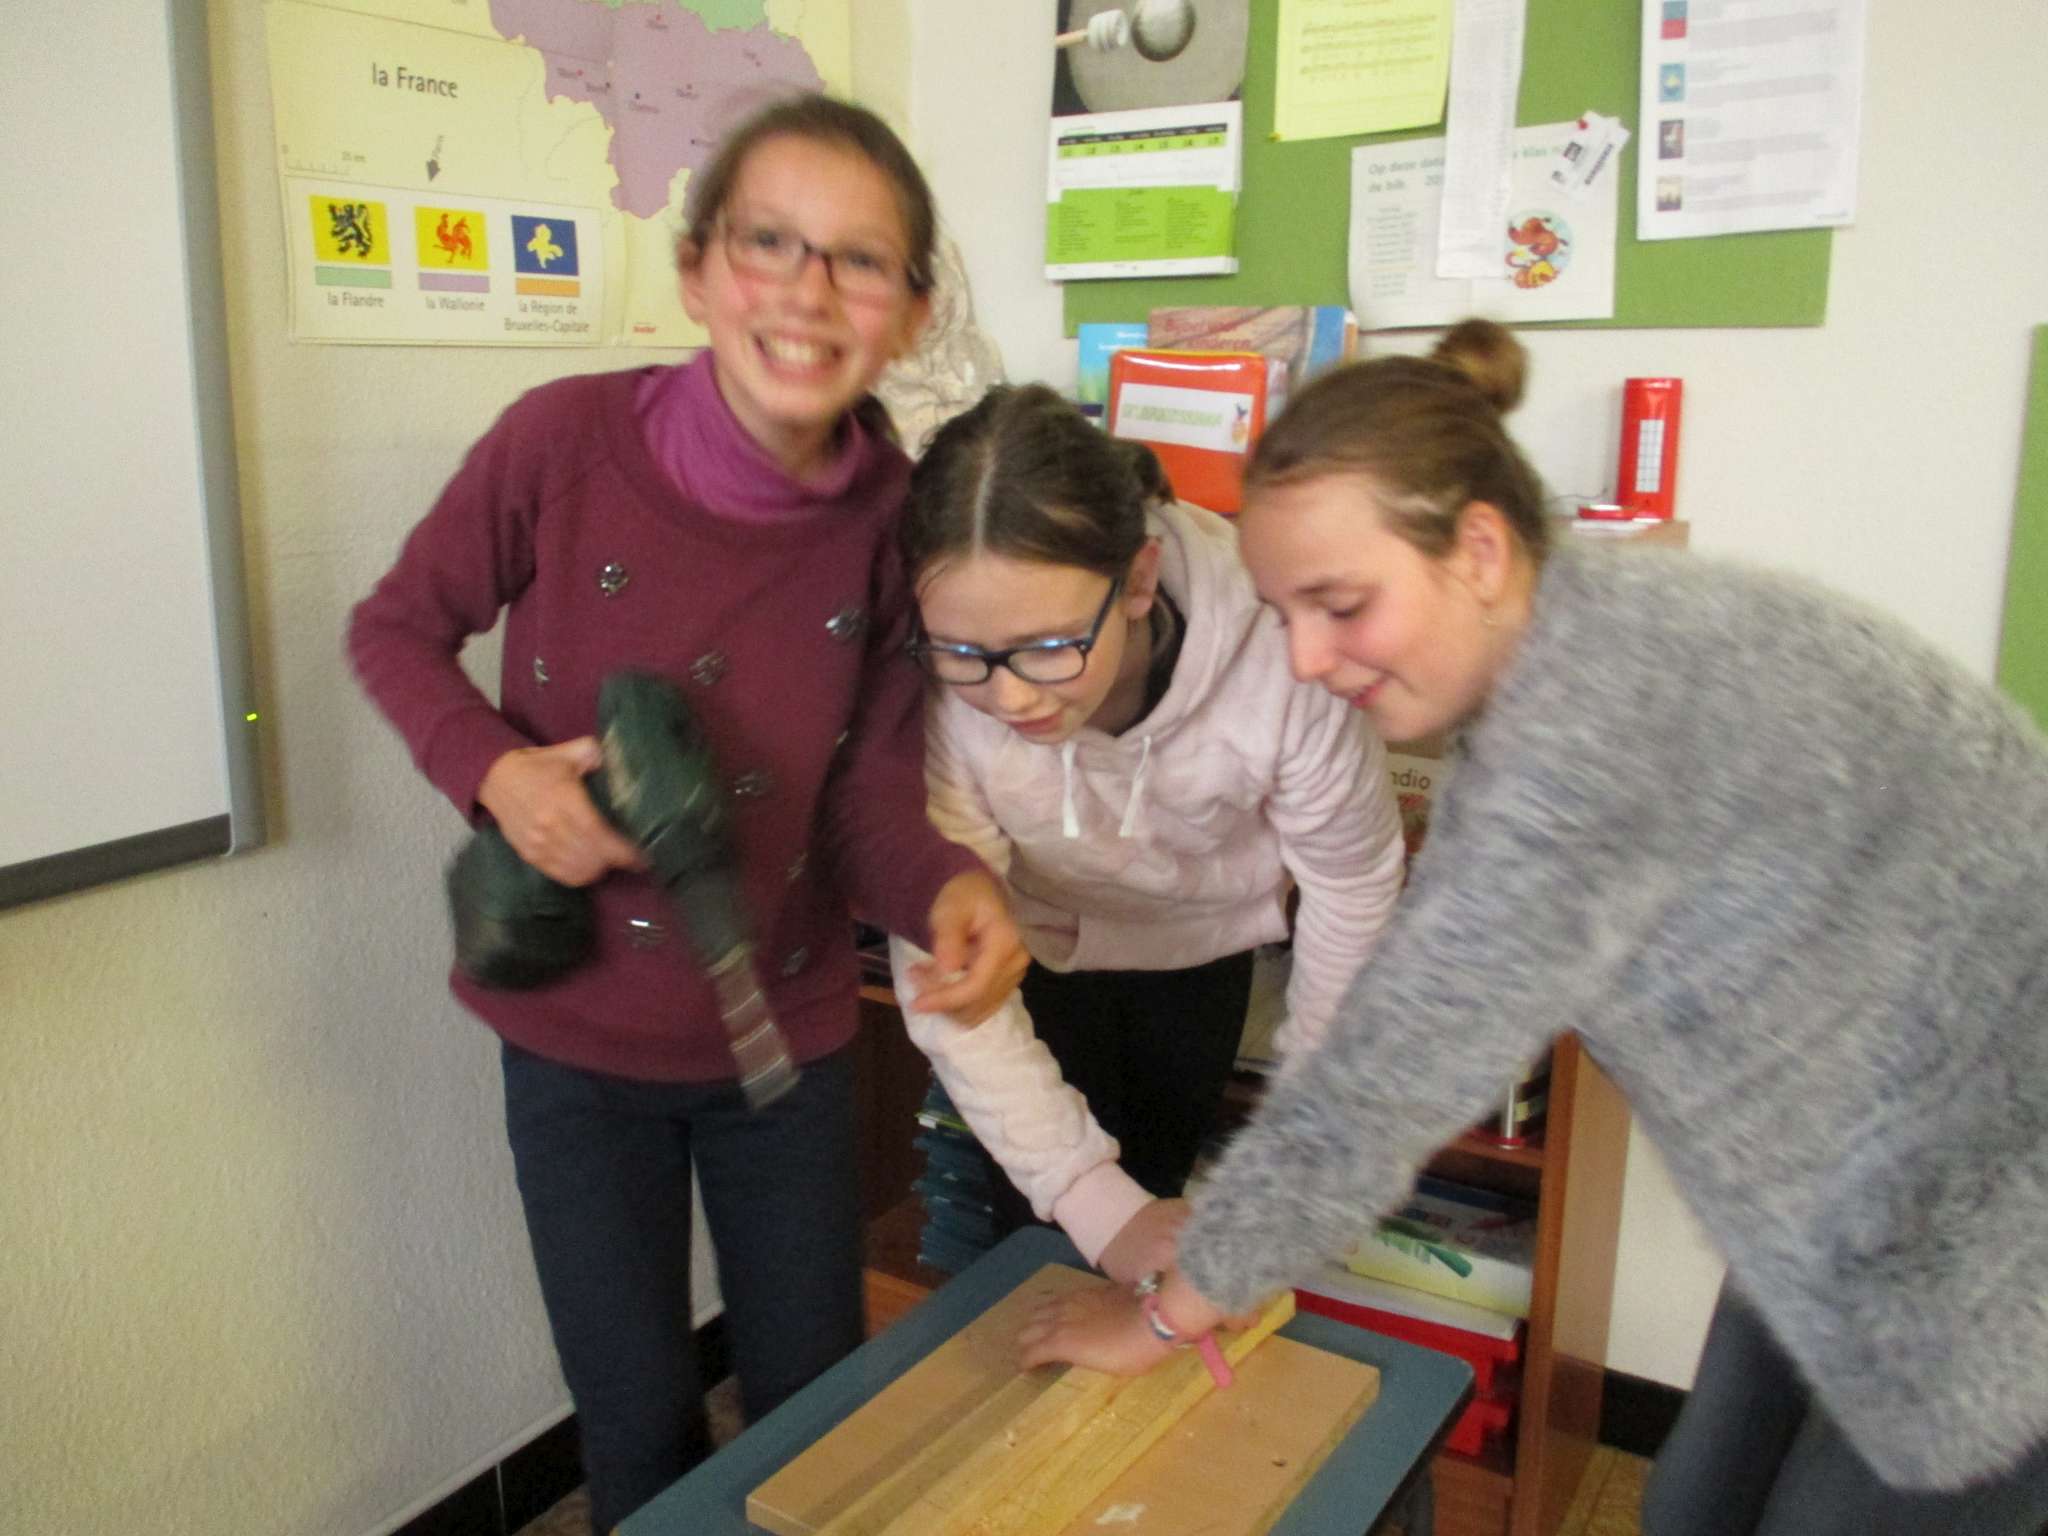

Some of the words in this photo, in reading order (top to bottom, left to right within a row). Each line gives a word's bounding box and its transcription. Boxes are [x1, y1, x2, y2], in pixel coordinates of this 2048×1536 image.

[372, 62, 388, 87] la
[397, 66, 458, 98] France
[327, 292, 338, 306] la
[342, 292, 384, 308] Flandre
[425, 297, 435, 310] la
[439, 297, 485, 312] Wallonie
[519, 300, 528, 313] la
